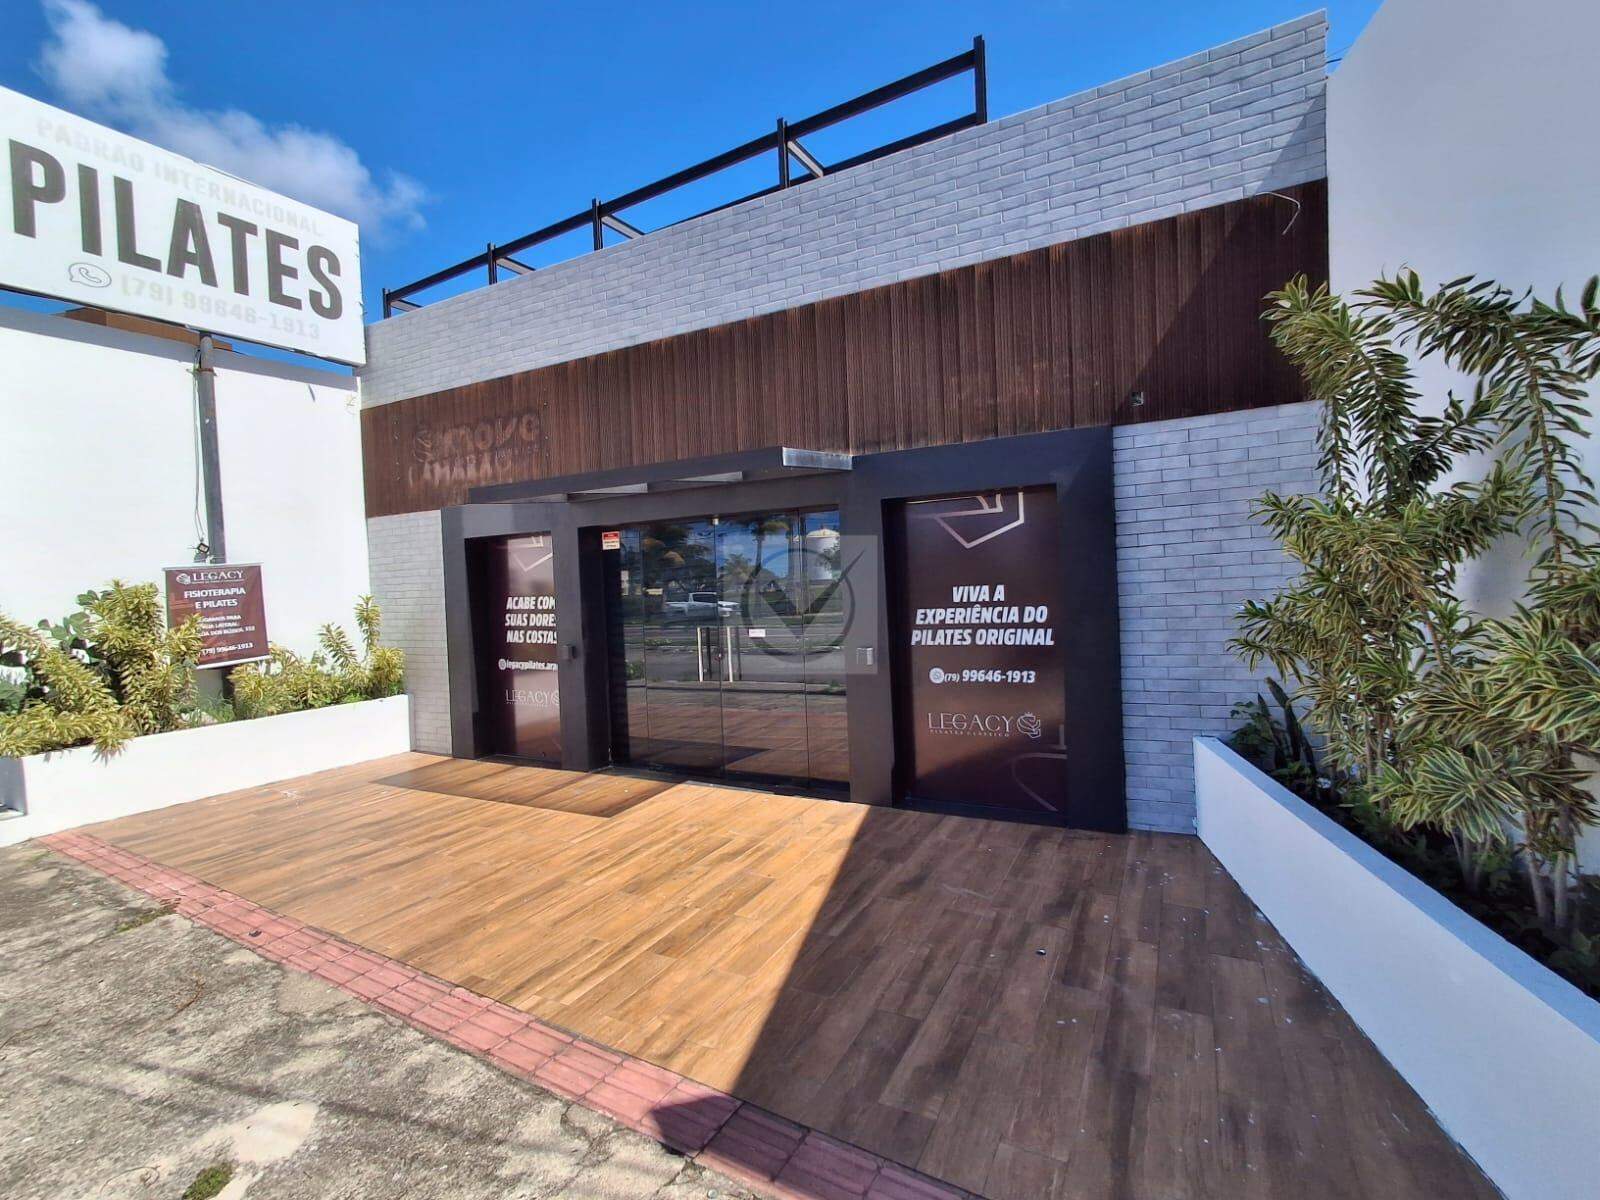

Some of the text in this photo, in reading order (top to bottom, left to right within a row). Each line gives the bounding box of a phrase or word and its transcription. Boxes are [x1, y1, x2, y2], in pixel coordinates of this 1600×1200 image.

[154, 160, 325, 238] INTERNACIONAL
[8, 137, 343, 321] PILATES
[192, 570, 244, 582] LEGACY
[183, 587, 246, 599] FISIOTERAPIA
[952, 584, 1005, 602] VIVA A
[195, 598, 238, 609] E PILATES
[506, 596, 536, 610] ACABE
[505, 613, 557, 627] SUAS DORE
[915, 604, 1048, 625] EXPERIÊNCIA DO
[506, 630, 525, 644] NAS
[911, 628, 1055, 646] PILATES ORIGINAL
[944, 669, 1036, 684] (79) 99646-1913
[505, 689, 550, 704] LEGACY
[928, 712, 1014, 733] LEGACY
